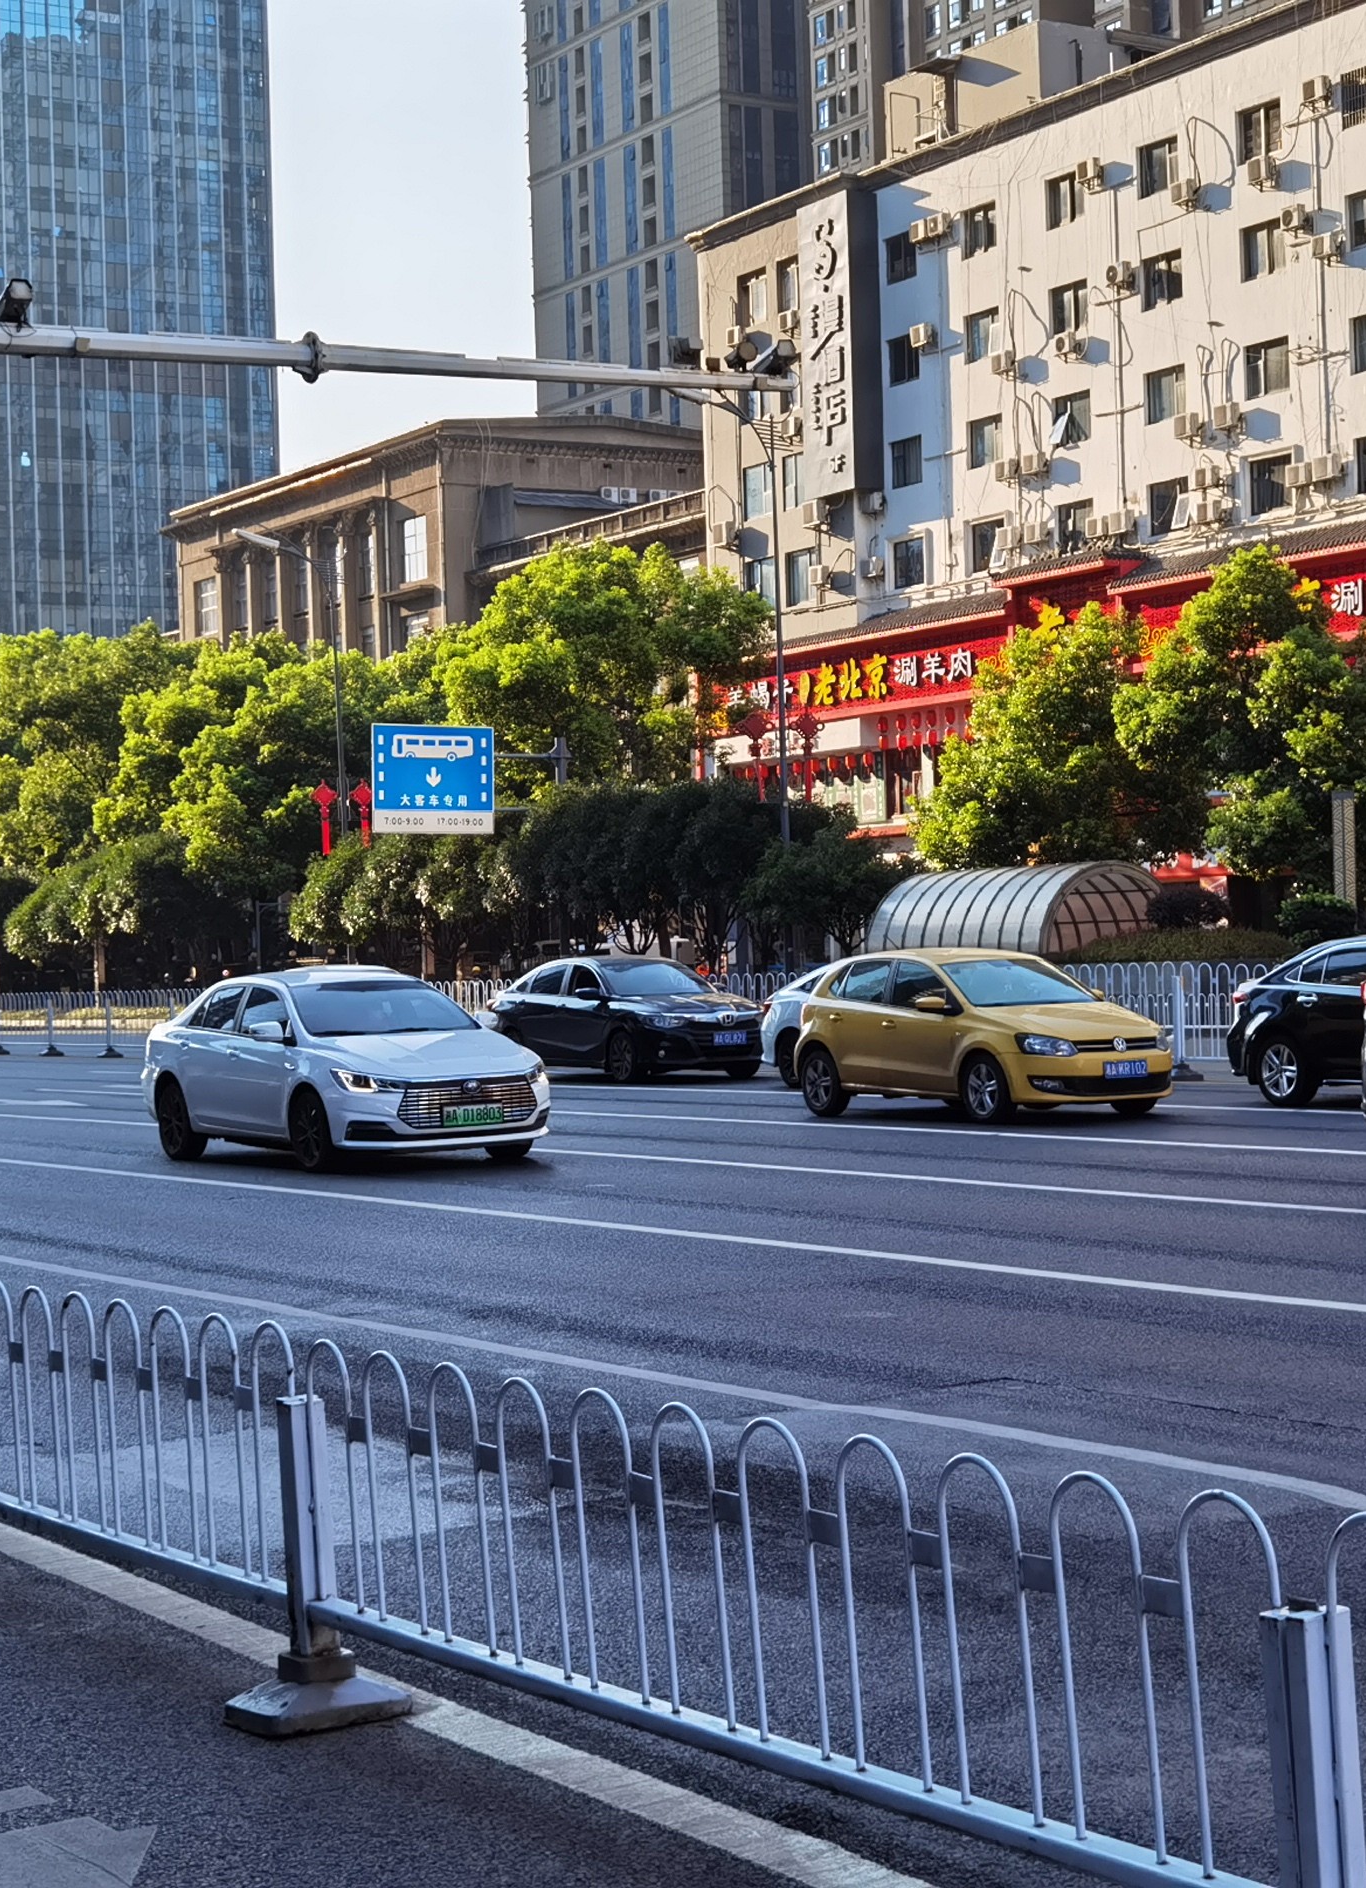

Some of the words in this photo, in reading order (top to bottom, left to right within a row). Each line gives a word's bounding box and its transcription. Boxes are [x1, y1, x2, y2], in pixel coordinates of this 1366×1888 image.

[400, 794, 468, 807] 大客车专用
[384, 816, 425, 826] 7:00-9:00
[436, 817, 484, 827] 17:00-19:00
